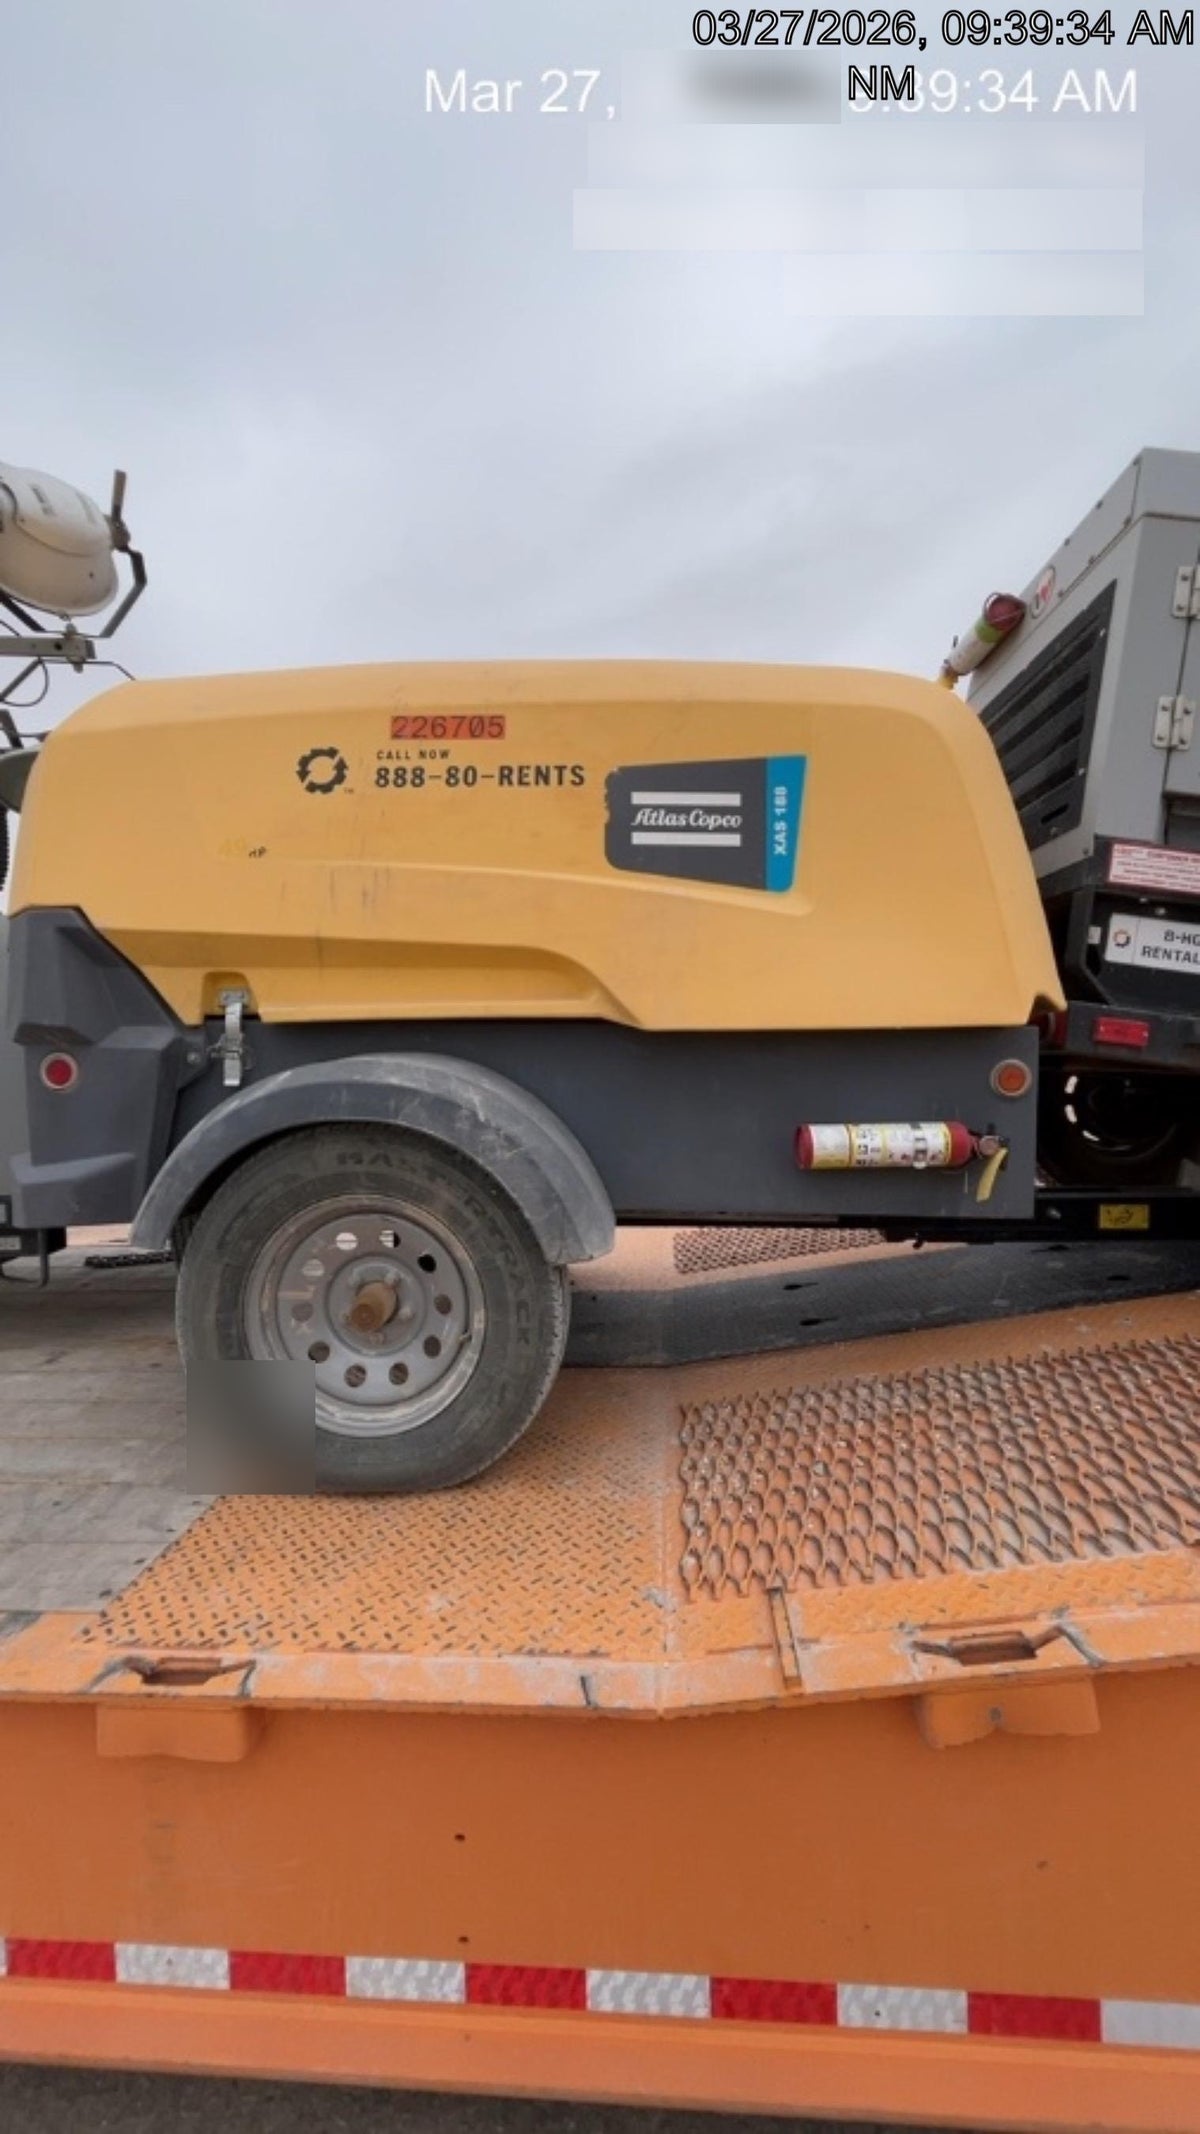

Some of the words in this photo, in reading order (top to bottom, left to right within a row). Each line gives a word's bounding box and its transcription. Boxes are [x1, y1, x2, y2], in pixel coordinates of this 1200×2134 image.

[391, 715, 505, 740] 226705
[376, 750, 412, 760] CALL
[419, 749, 451, 760] NOW
[374, 765, 586, 788] 888-80-RENTS
[772, 822, 788, 855] XAS
